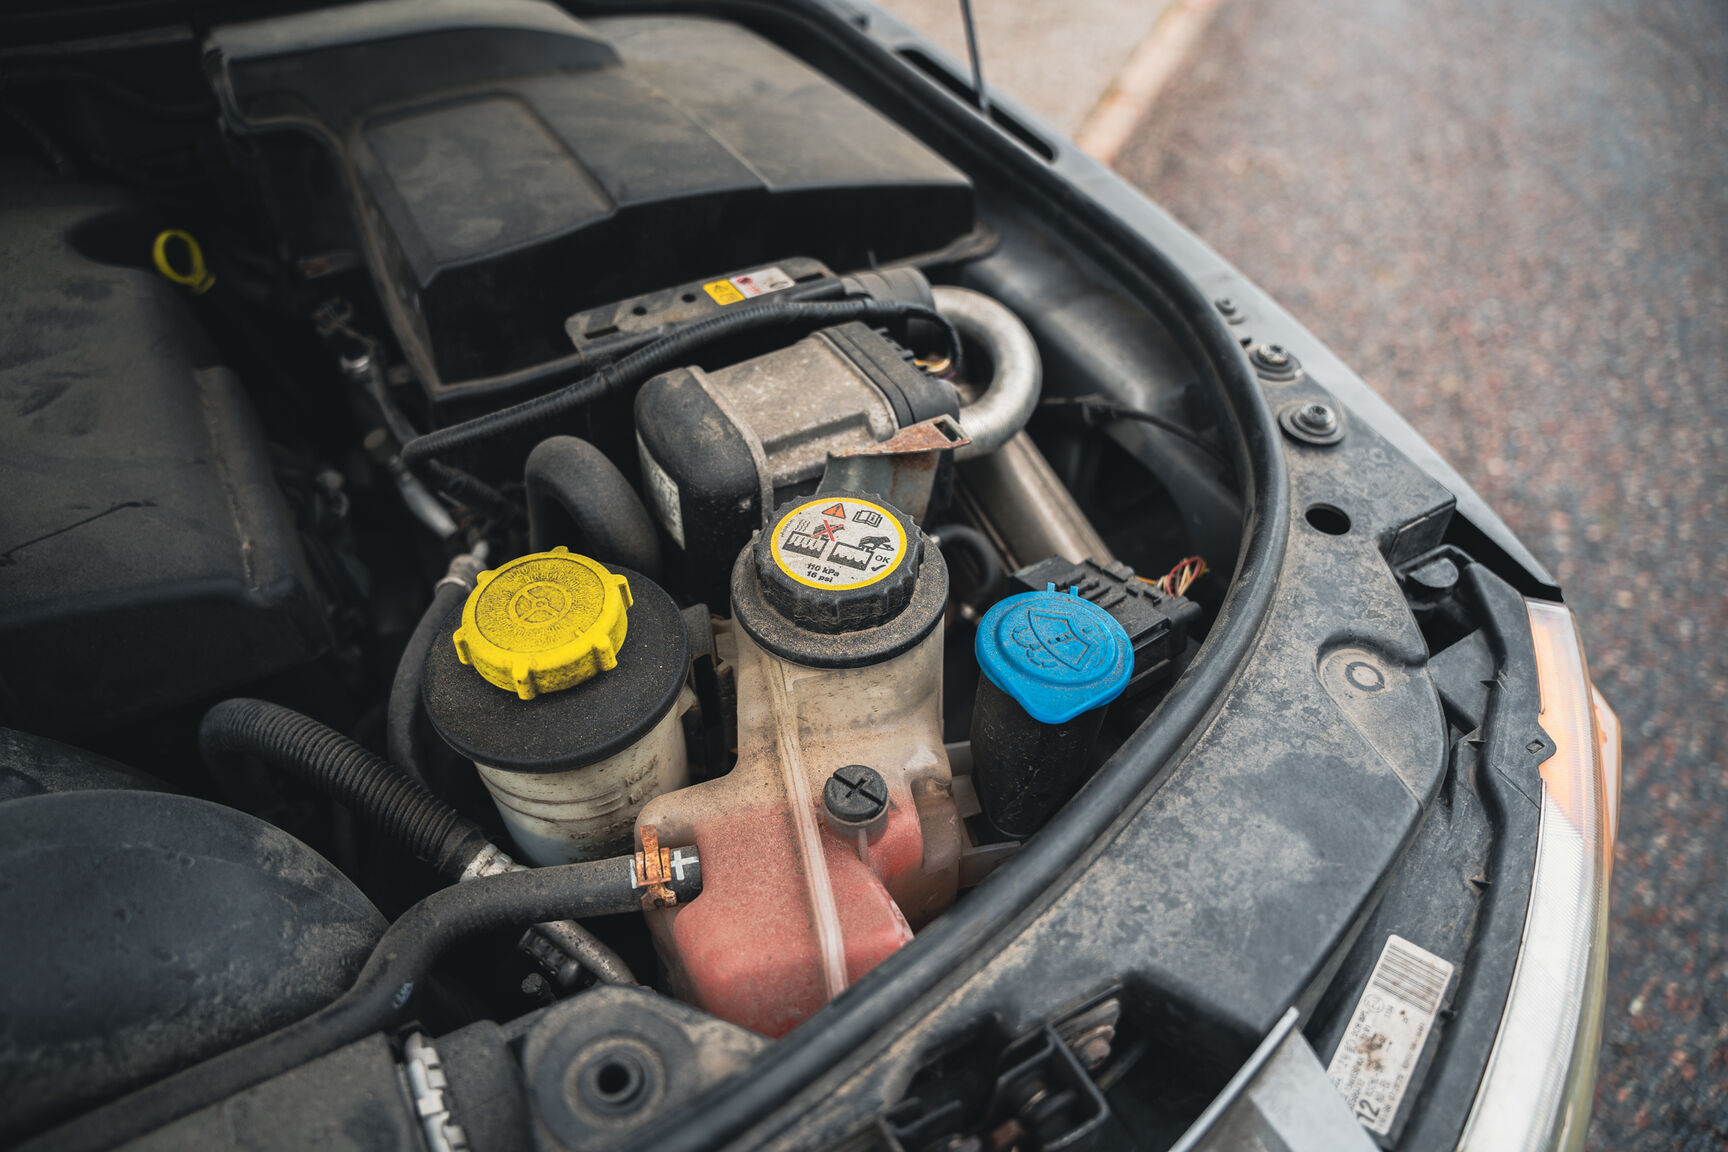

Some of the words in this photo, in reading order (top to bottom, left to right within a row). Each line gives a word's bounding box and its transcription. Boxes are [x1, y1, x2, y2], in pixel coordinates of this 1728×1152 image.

[874, 555, 891, 564] OK
[806, 562, 820, 572] 110
[822, 567, 840, 577] kPa
[806, 571, 817, 579] 16
[818, 575, 834, 583] psi
[1356, 1099, 1381, 1124] 12
